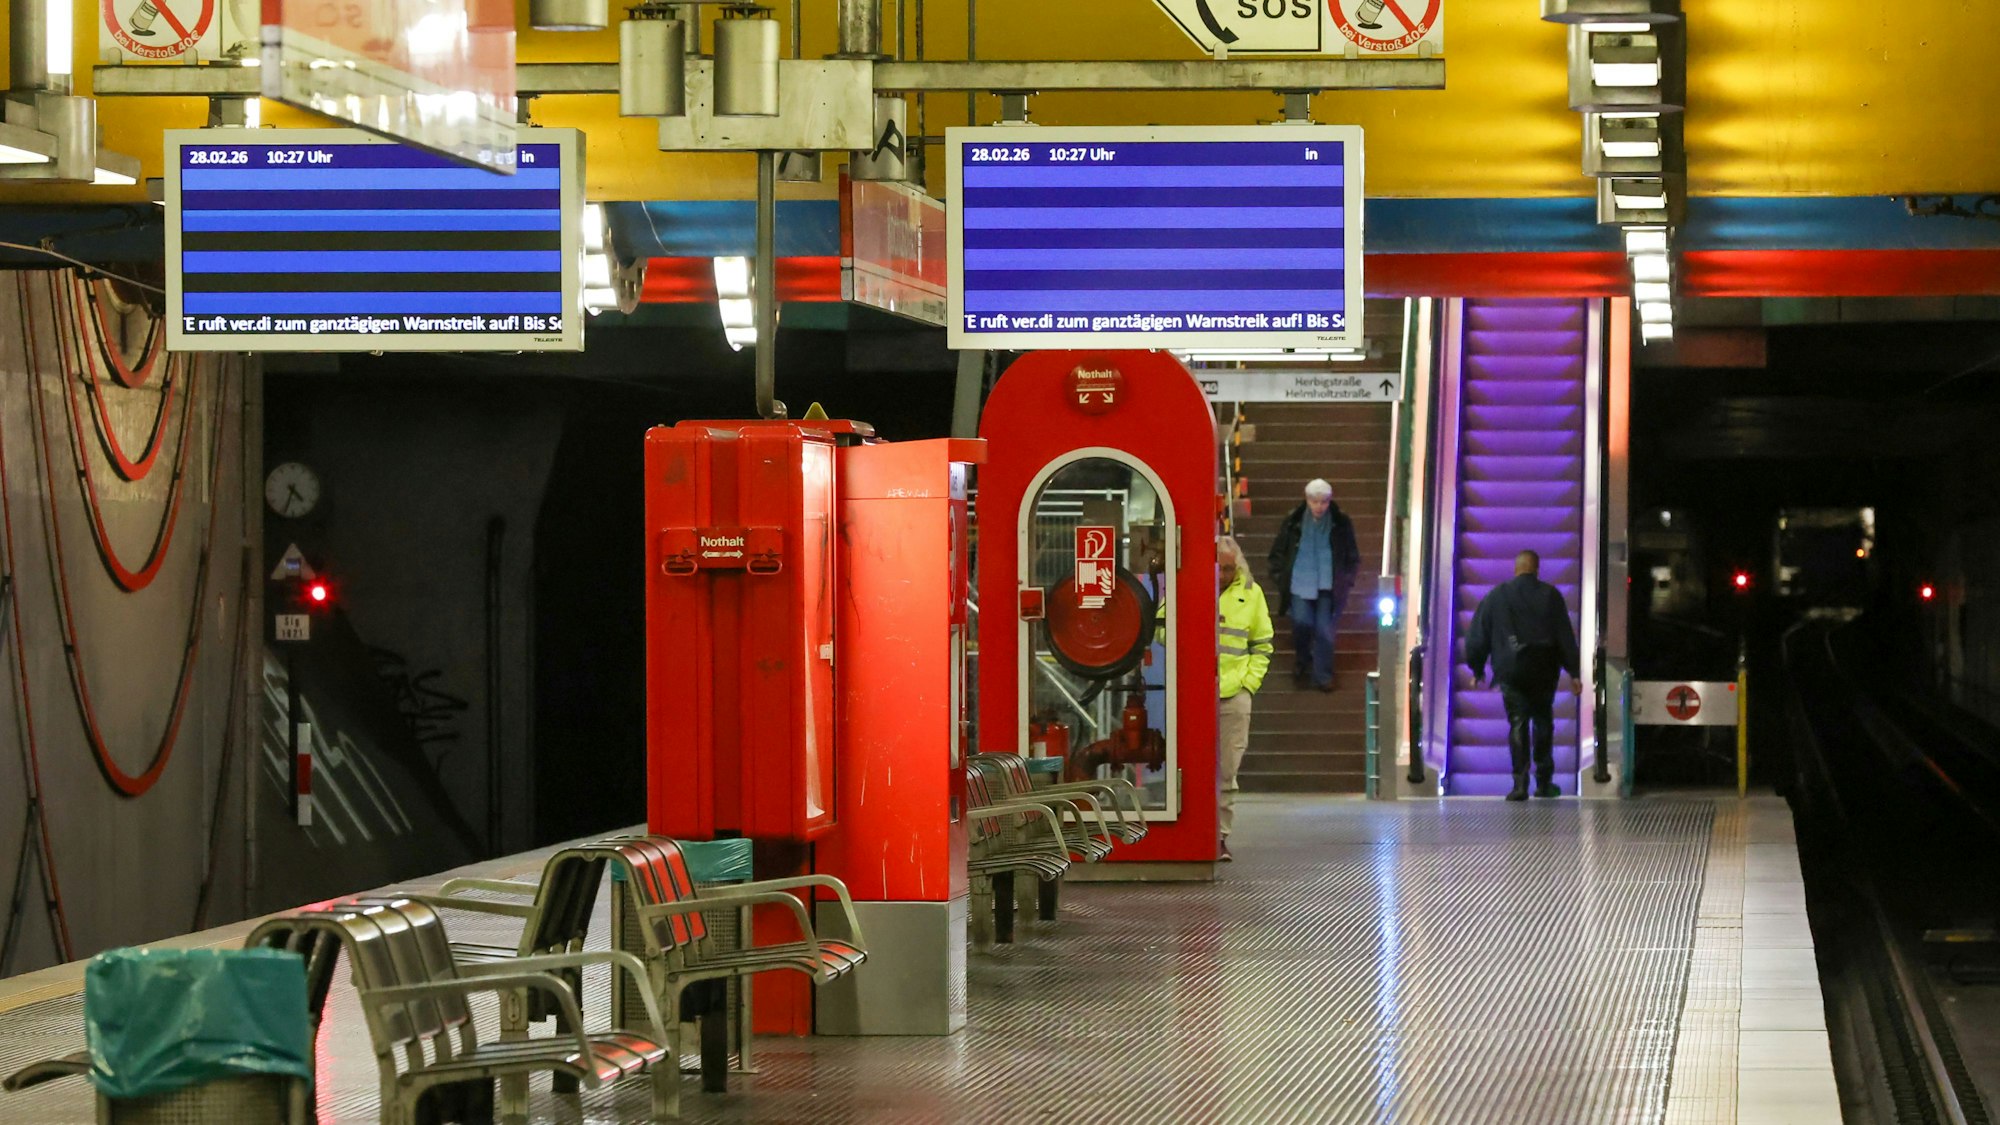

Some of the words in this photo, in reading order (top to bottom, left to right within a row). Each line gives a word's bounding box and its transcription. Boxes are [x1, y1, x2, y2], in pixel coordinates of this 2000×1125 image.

[1236, 0, 1312, 19] SOS
[113, 30, 131, 47] bei
[131, 41, 176, 58] Verstoß
[178, 30, 202, 51] 40€
[1339, 23, 1357, 41] bei
[1356, 36, 1403, 51] Verstoß
[1405, 23, 1428, 44] 40€
[189, 150, 249, 164] 28.02.26
[267, 150, 304, 164] 10:27
[307, 150, 334, 164] Uhr
[521, 150, 535, 163] in
[971, 148, 1031, 162] 28.02.26
[1049, 148, 1087, 161] 10:27
[1090, 147, 1116, 161] Uhr
[1305, 147, 1318, 161] in
[198, 316, 227, 331] ruft
[229, 316, 272, 331] ver.di
[274, 319, 306, 331] zum
[310, 315, 400, 334] ganztägigen
[403, 315, 486, 331] Warnstreik
[488, 316, 519, 331] auf!
[523, 315, 545, 331] Bis
[980, 313, 1008, 329] ruft
[1011, 313, 1053, 329] ver.di
[1056, 316, 1088, 329] zum
[1091, 313, 1183, 332] ganztägigen
[1186, 313, 1270, 329] Warnstreik
[1272, 313, 1303, 329] auf!
[1307, 313, 1329, 328] Bis
[1077, 369, 1113, 380] Nothalt
[1294, 376, 1362, 389] Herbigstraße
[1285, 388, 1372, 399] Helmholtzstraße
[700, 536, 745, 547] Nothalt
